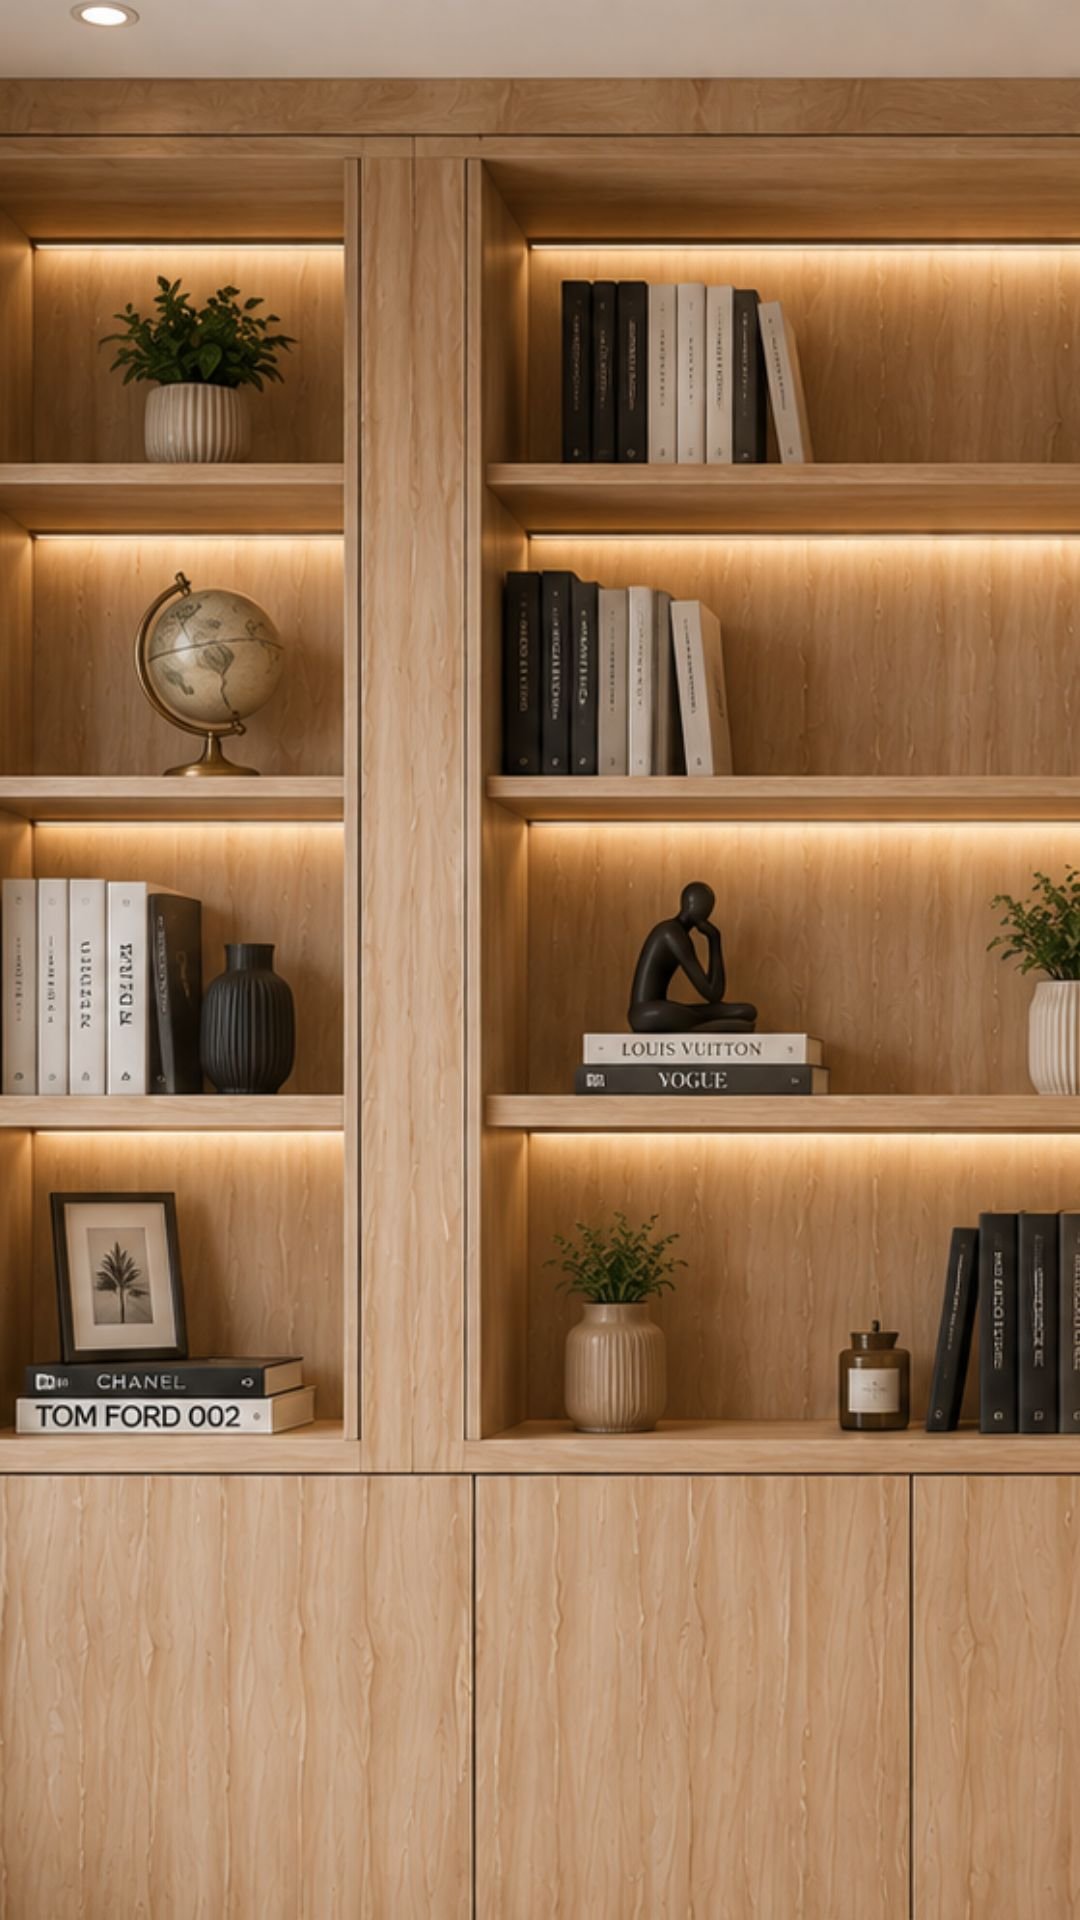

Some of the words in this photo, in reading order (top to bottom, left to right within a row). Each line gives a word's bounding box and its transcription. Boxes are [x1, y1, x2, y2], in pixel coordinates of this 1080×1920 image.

[622, 1041, 676, 1057] LOUIS
[681, 1041, 763, 1057] VUITTON
[657, 1071, 729, 1089] VOGUE
[96, 1373, 186, 1391] CHANEL
[35, 1404, 97, 1427] TOM
[105, 1404, 181, 1427] FORD
[188, 1404, 241, 1427] 002
